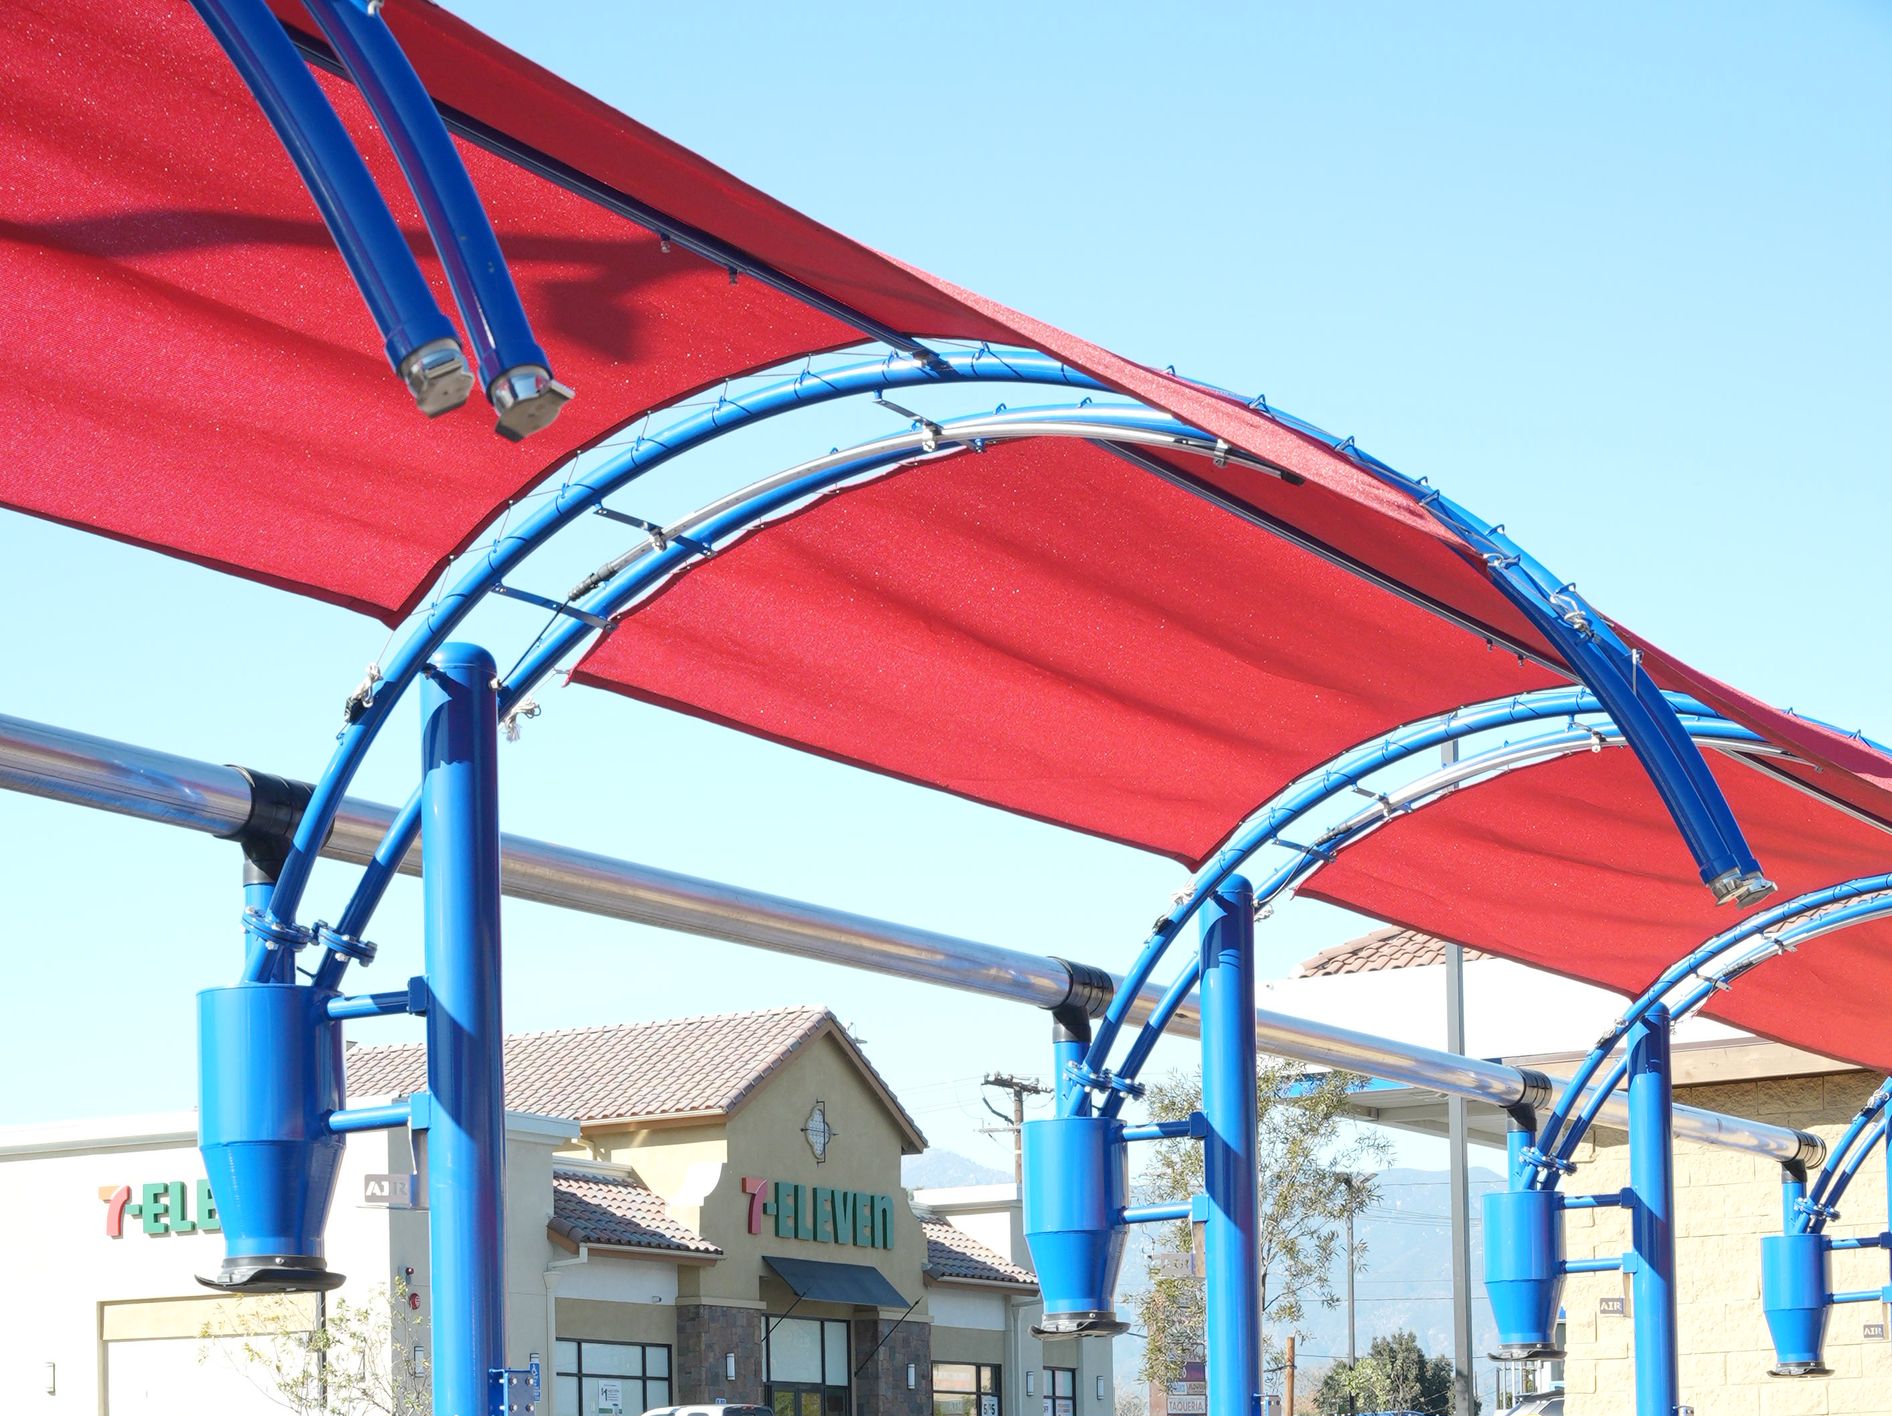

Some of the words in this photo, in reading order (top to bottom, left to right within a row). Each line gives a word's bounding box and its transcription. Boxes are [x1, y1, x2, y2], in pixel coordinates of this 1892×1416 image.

[365, 1180, 408, 1196] AIR
[98, 1176, 224, 1239] 7-ELE
[1600, 1301, 1623, 1311] AIR
[1864, 1327, 1883, 1336] AIR
